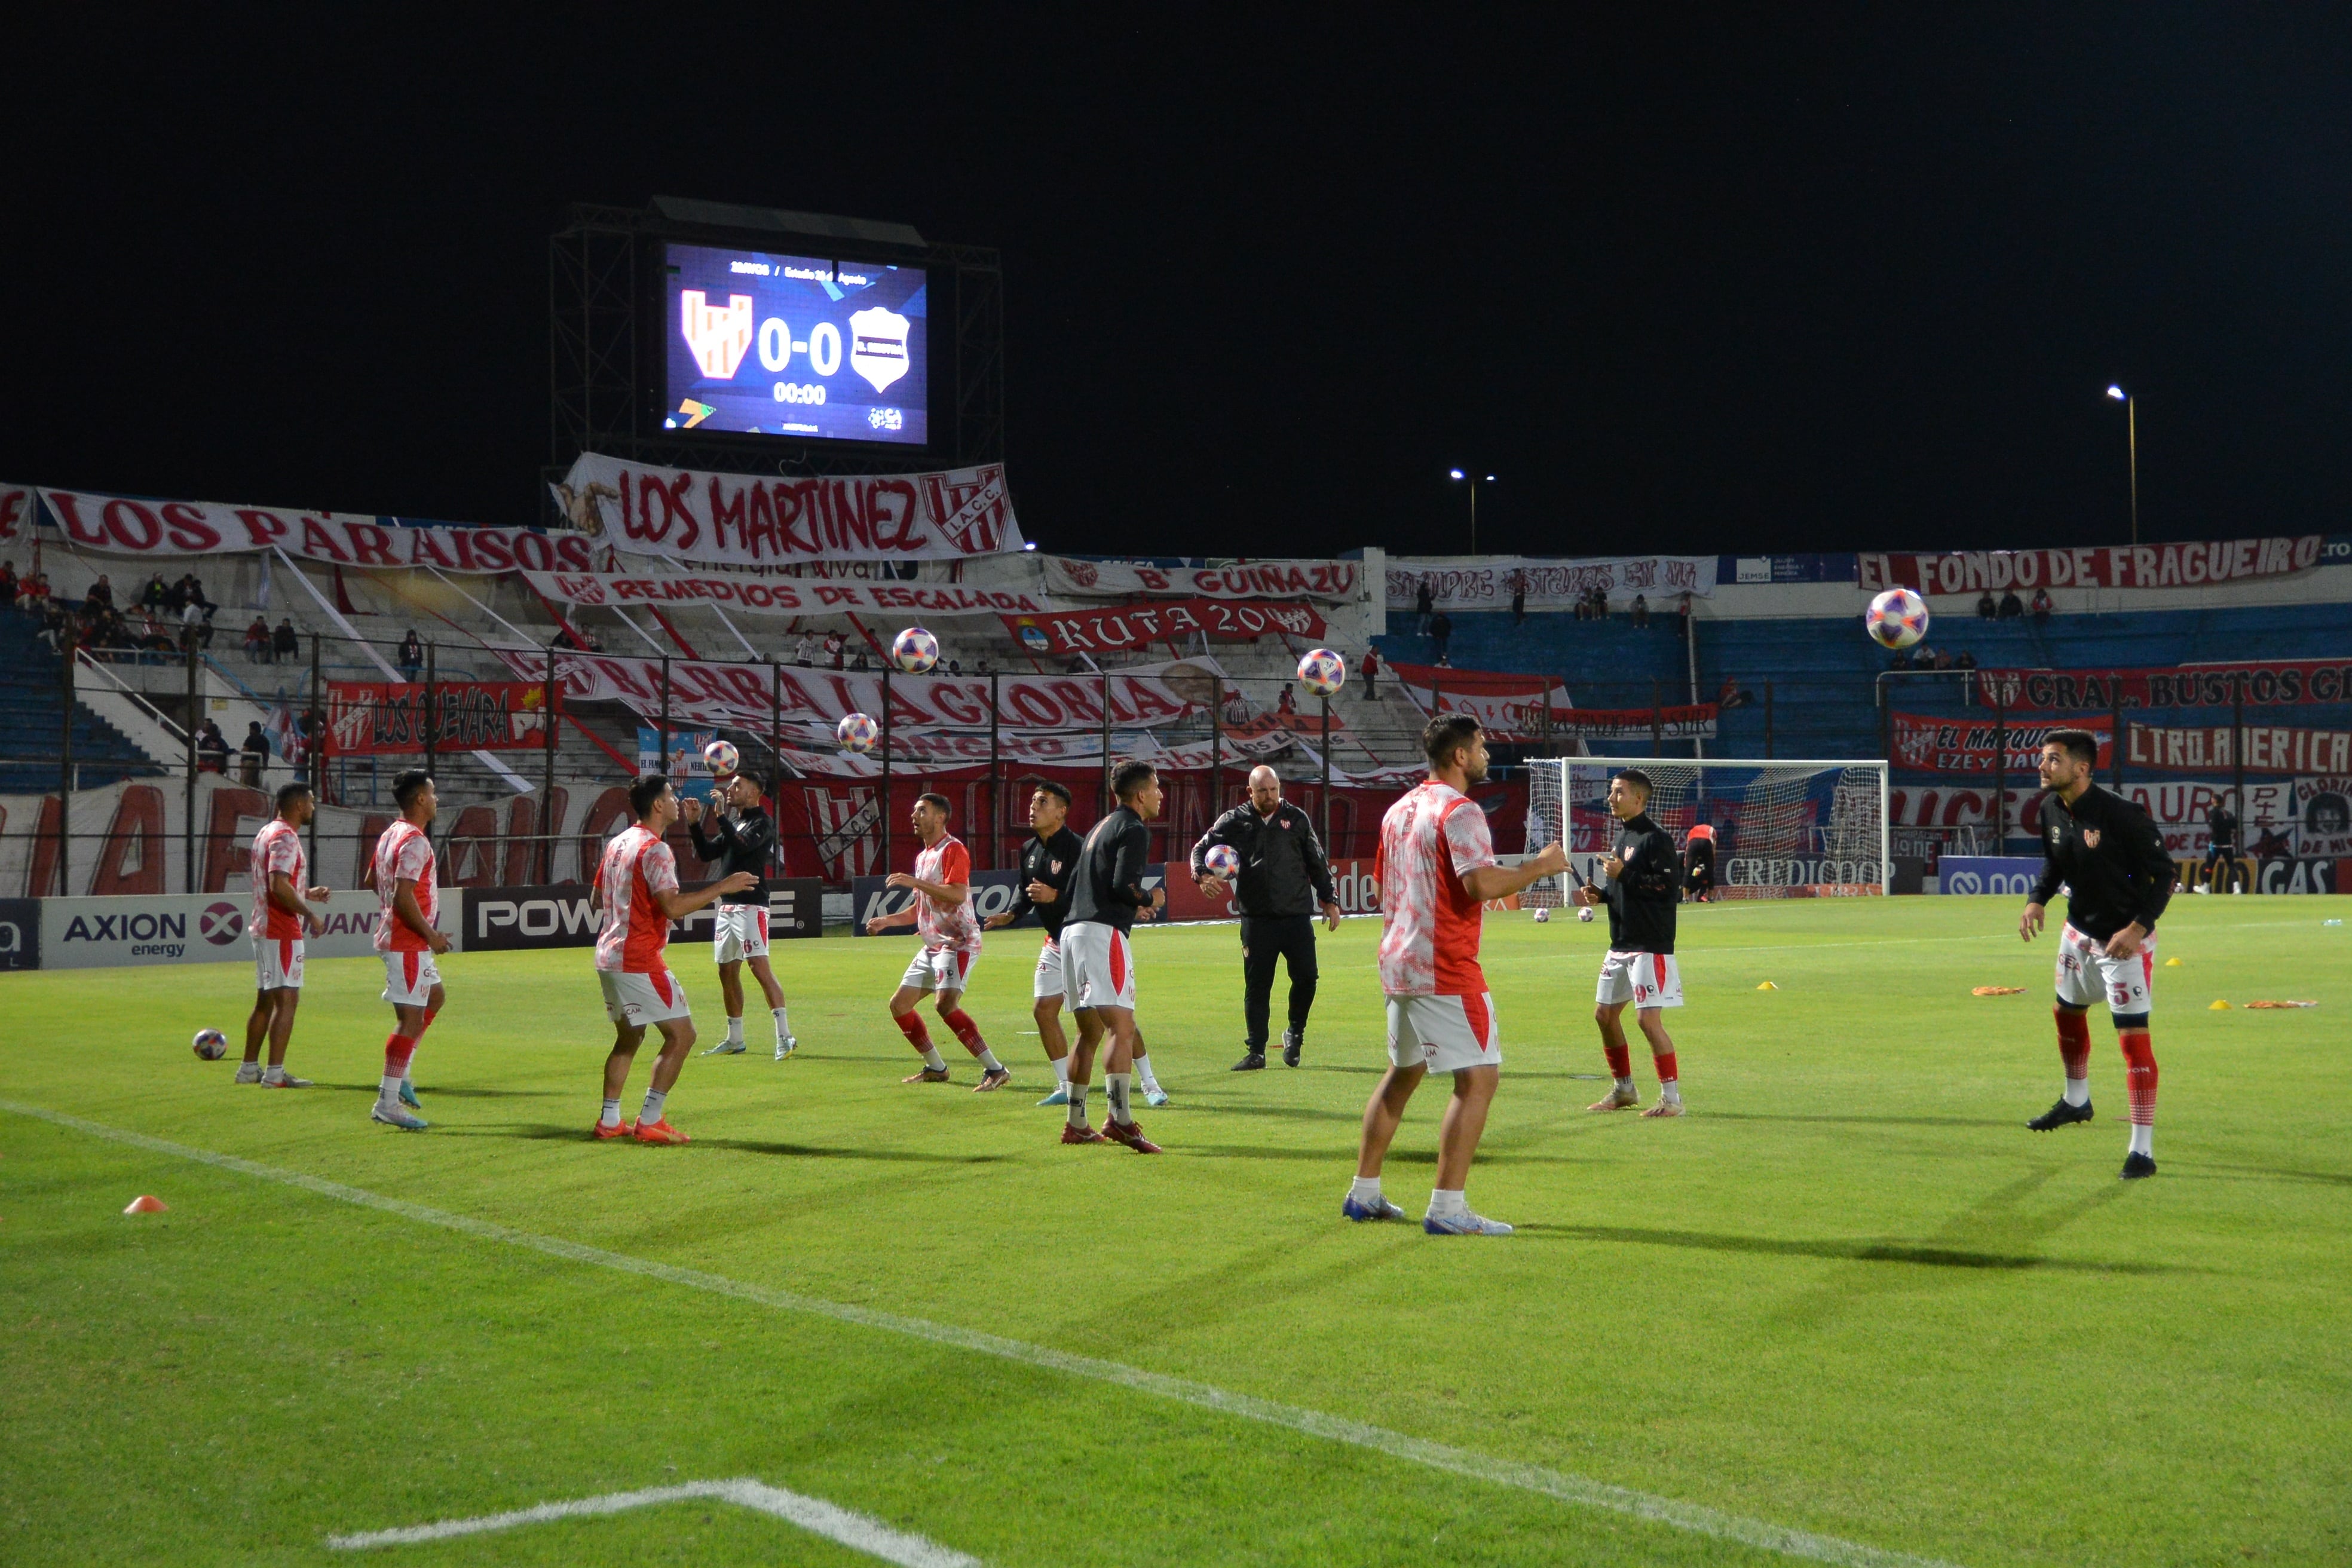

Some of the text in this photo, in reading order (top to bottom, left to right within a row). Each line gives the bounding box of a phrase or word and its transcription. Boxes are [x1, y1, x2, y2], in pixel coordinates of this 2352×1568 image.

[758, 317, 842, 376] 0-0
[773, 381, 826, 405] 00:00
[619, 469, 927, 559] LOS MARTINEZ
[49, 492, 594, 573] LOS PARAISOS
[1858, 535, 2322, 595] EL FONDO DE FRAGUEIRO
[611, 578, 1040, 612] REMEDIOS DE ESCALADA
[1052, 604, 1266, 649] RUTA 20
[595, 659, 833, 721] BARRA
[930, 675, 1184, 725] GLORIA
[2027, 674, 2141, 710] GRAL.
[2148, 669, 2302, 707] BUSTOS
[372, 690, 411, 746] LOS
[1937, 725, 1959, 750] EL
[1937, 754, 1972, 770] EZE
[1979, 756, 1994, 770] Y
[2300, 840, 2323, 853] DE
[1726, 858, 1897, 887] CREDICOOP
[63, 913, 186, 942] AXION
[131, 943, 186, 957] energy
[1635, 984, 1646, 1003] 9
